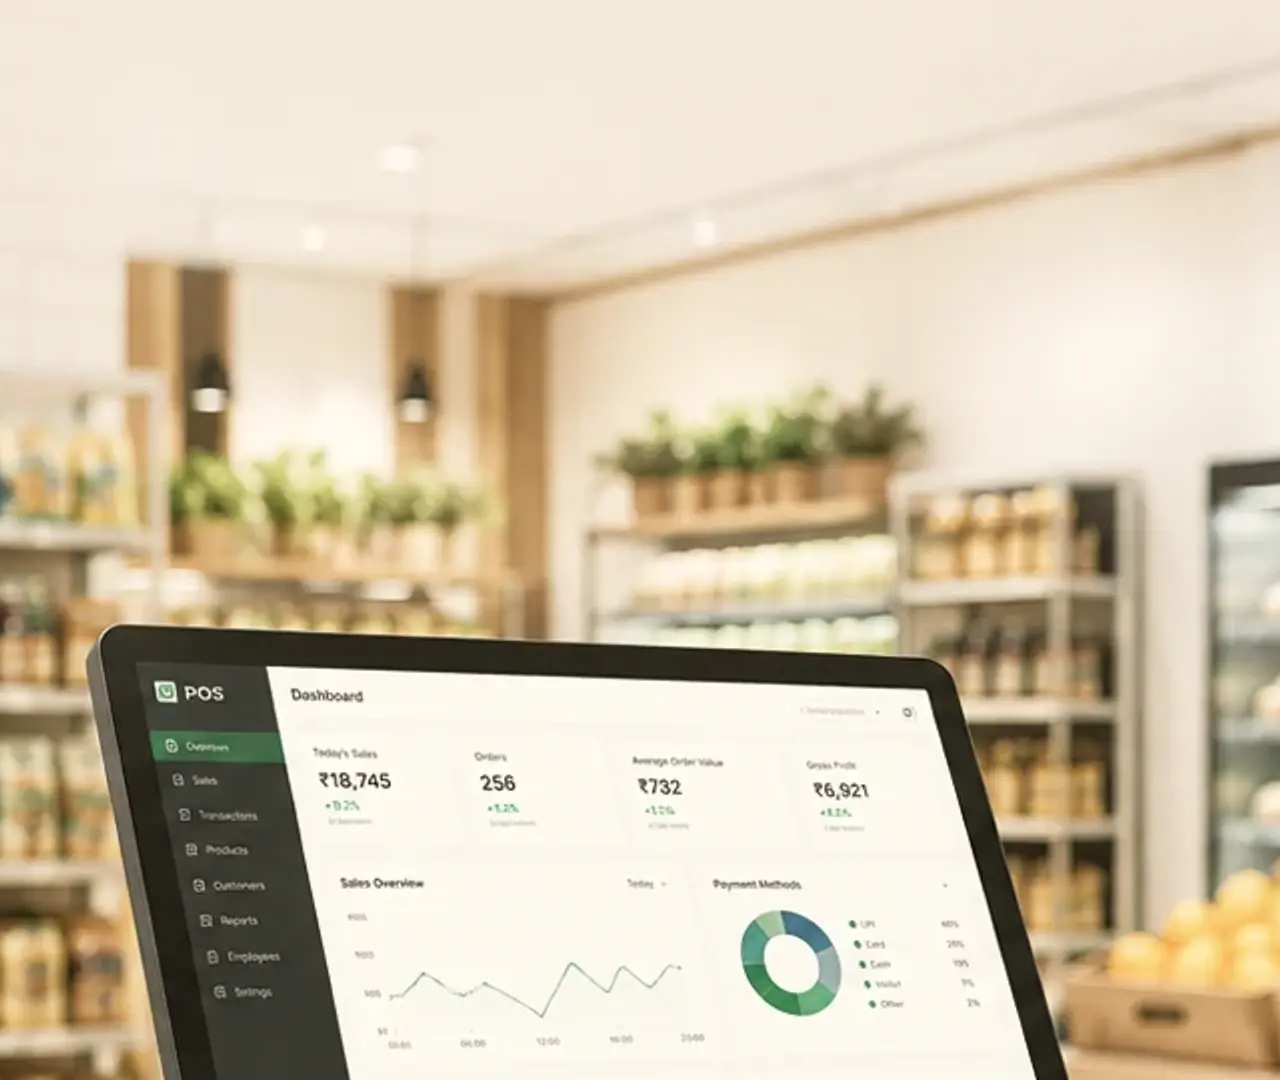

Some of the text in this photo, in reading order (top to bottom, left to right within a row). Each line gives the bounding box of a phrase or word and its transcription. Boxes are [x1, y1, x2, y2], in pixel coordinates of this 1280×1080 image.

[184, 686, 224, 701] POS
[290, 688, 363, 703] Dashboard
[319, 772, 391, 791] ₹18,745
[480, 774, 516, 791] 256
[638, 778, 682, 795] ₹732
[813, 782, 869, 800] ₹6,921
[340, 877, 424, 889] Sales Overview
[713, 879, 802, 891] Payment Methods
